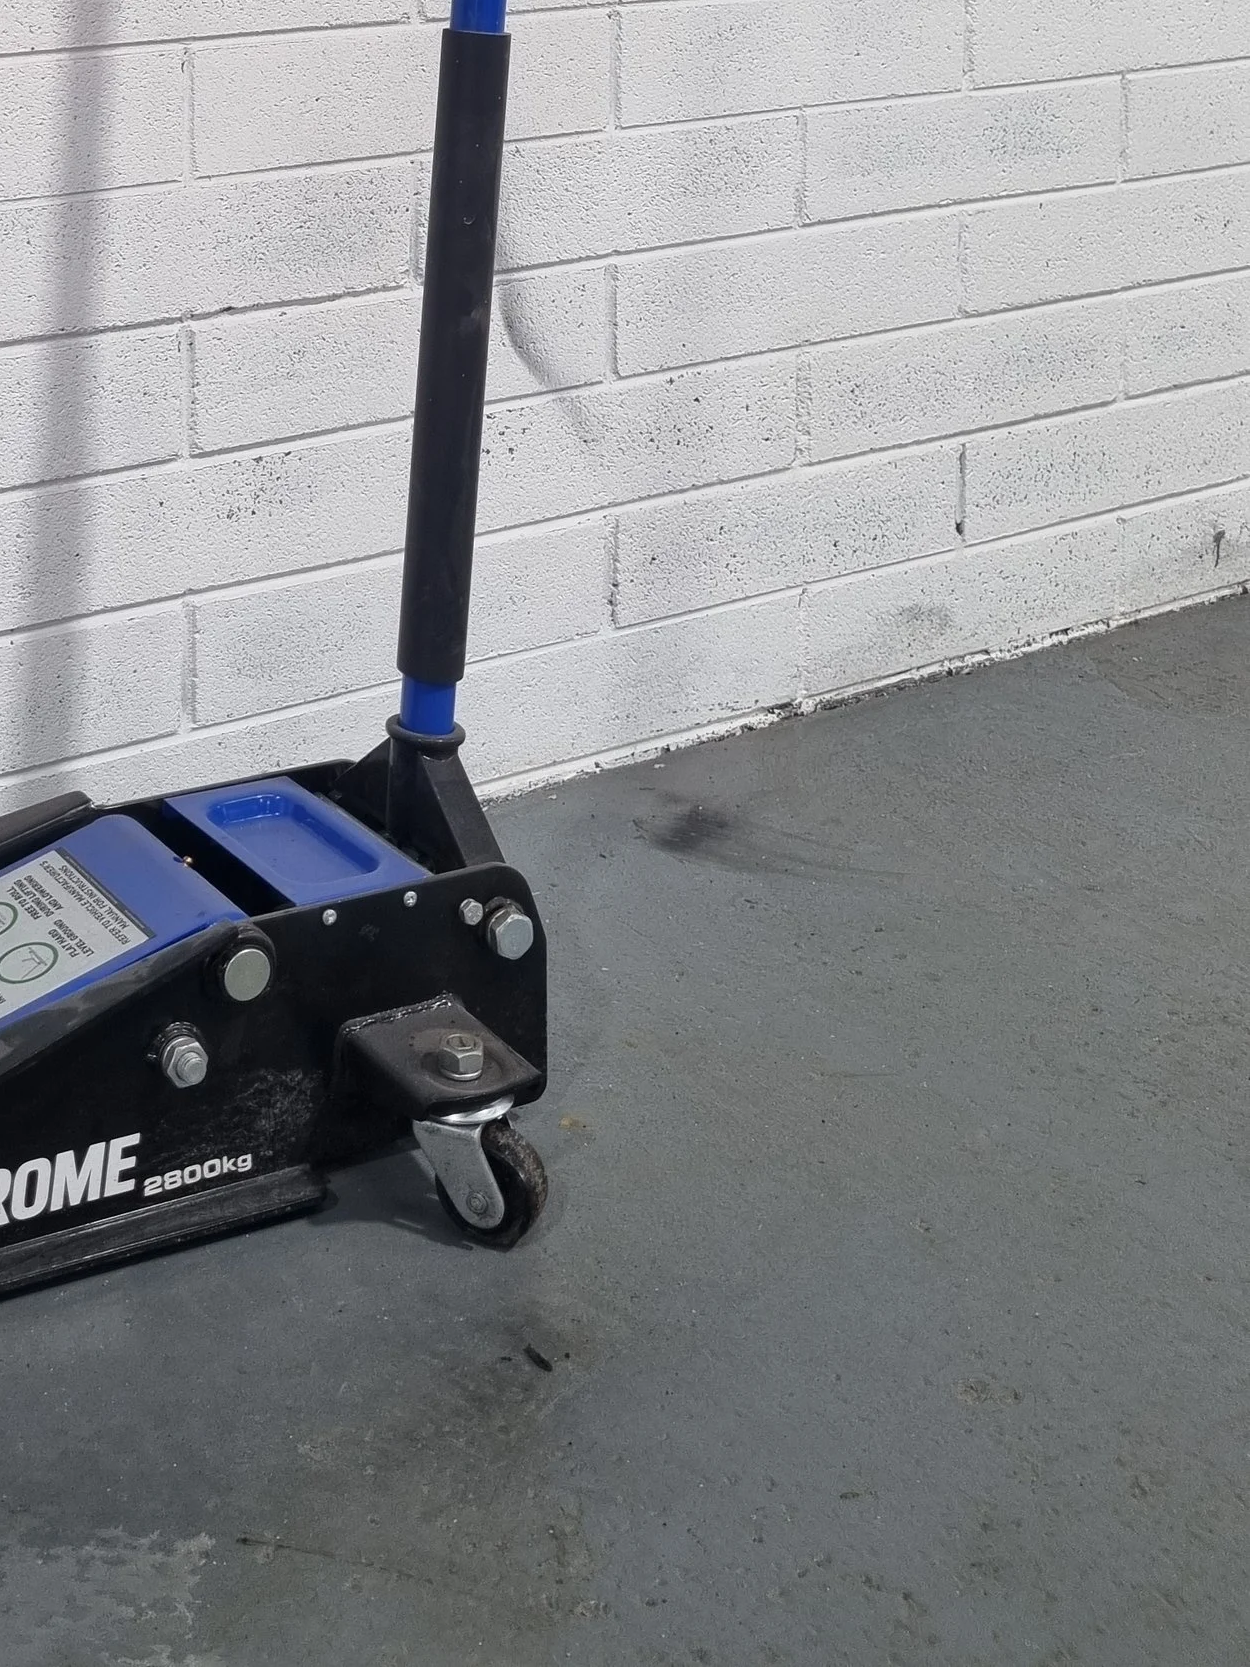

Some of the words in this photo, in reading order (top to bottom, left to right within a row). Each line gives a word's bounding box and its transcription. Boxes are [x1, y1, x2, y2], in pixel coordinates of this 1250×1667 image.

[12, 879, 36, 898] LIFTING
[23, 874, 53, 900] LOWERING
[37, 860, 87, 902] MANUFACTURER'S
[57, 865, 97, 898] INSTRUCTIONS
[4, 886, 23, 900] ROLL
[16, 898, 30, 907] TO
[90, 895, 108, 908] FOR
[24, 905, 43, 919] FREE
[31, 897, 55, 916] DURING
[47, 898, 64, 910] AND
[79, 900, 107, 922] VEHICLE
[100, 919, 113, 928] TO
[103, 907, 130, 928] MANUAL
[47, 928, 66, 944] HARD
[52, 919, 78, 940] GROUND
[107, 925, 131, 944] REFER
[61, 942, 79, 957] FLAT
[72, 938, 95, 956] LEVEL
[143, 1153, 252, 1197] 2800kg
